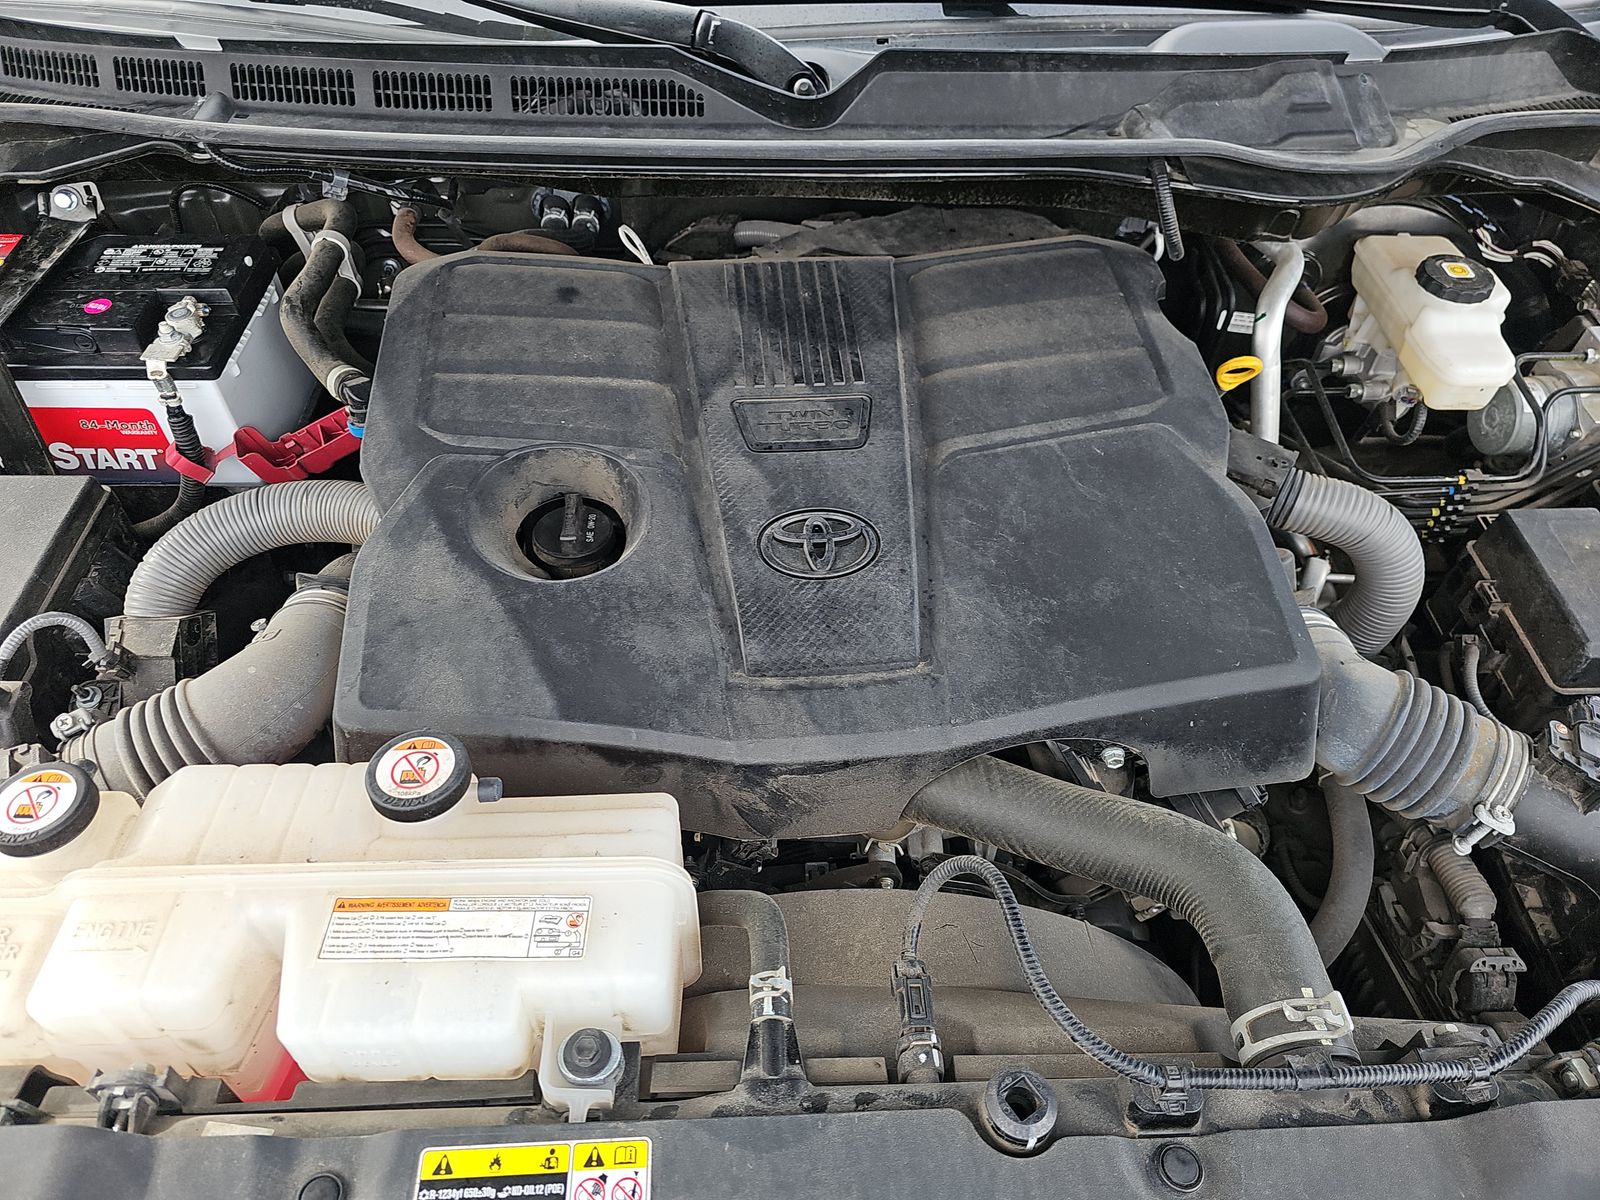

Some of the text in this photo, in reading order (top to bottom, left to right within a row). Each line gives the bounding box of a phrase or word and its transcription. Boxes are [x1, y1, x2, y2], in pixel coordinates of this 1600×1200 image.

[767, 409, 834, 420] TWIN
[585, 513, 597, 543] SAE 0W-20
[72, 921, 157, 938] ENGINE
